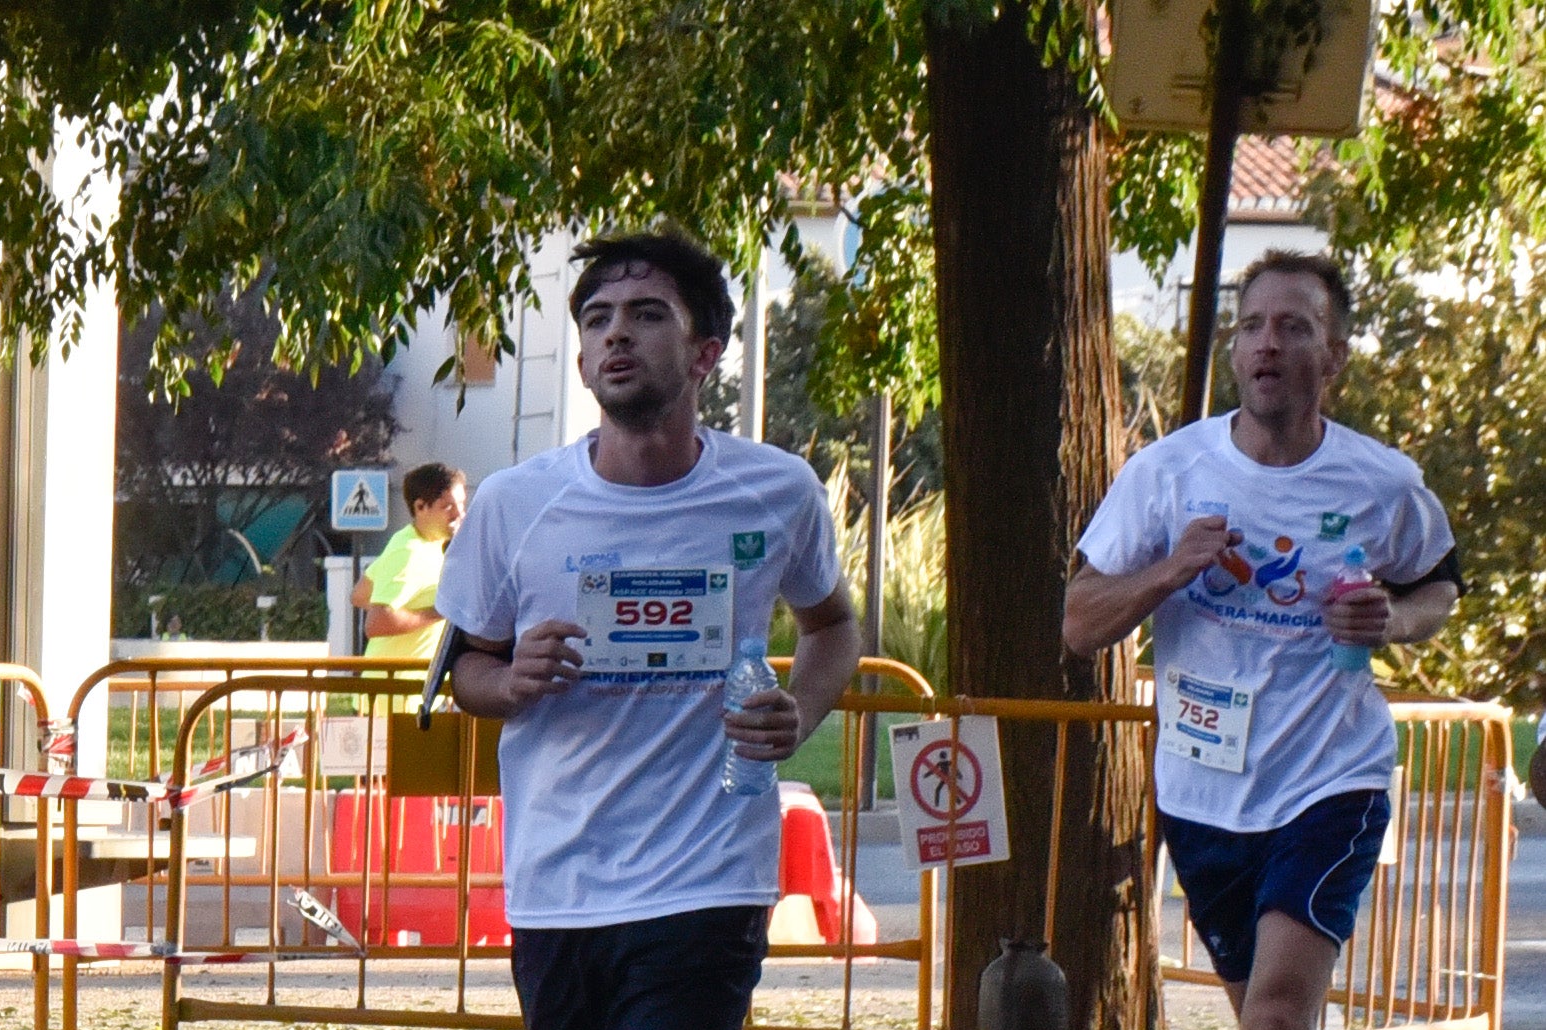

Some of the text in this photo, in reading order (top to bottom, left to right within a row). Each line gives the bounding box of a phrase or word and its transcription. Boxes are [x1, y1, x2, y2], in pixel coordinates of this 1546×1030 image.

[615, 600, 694, 626] 592
[1178, 699, 1220, 730] 752
[928, 840, 980, 857] EL ASO
